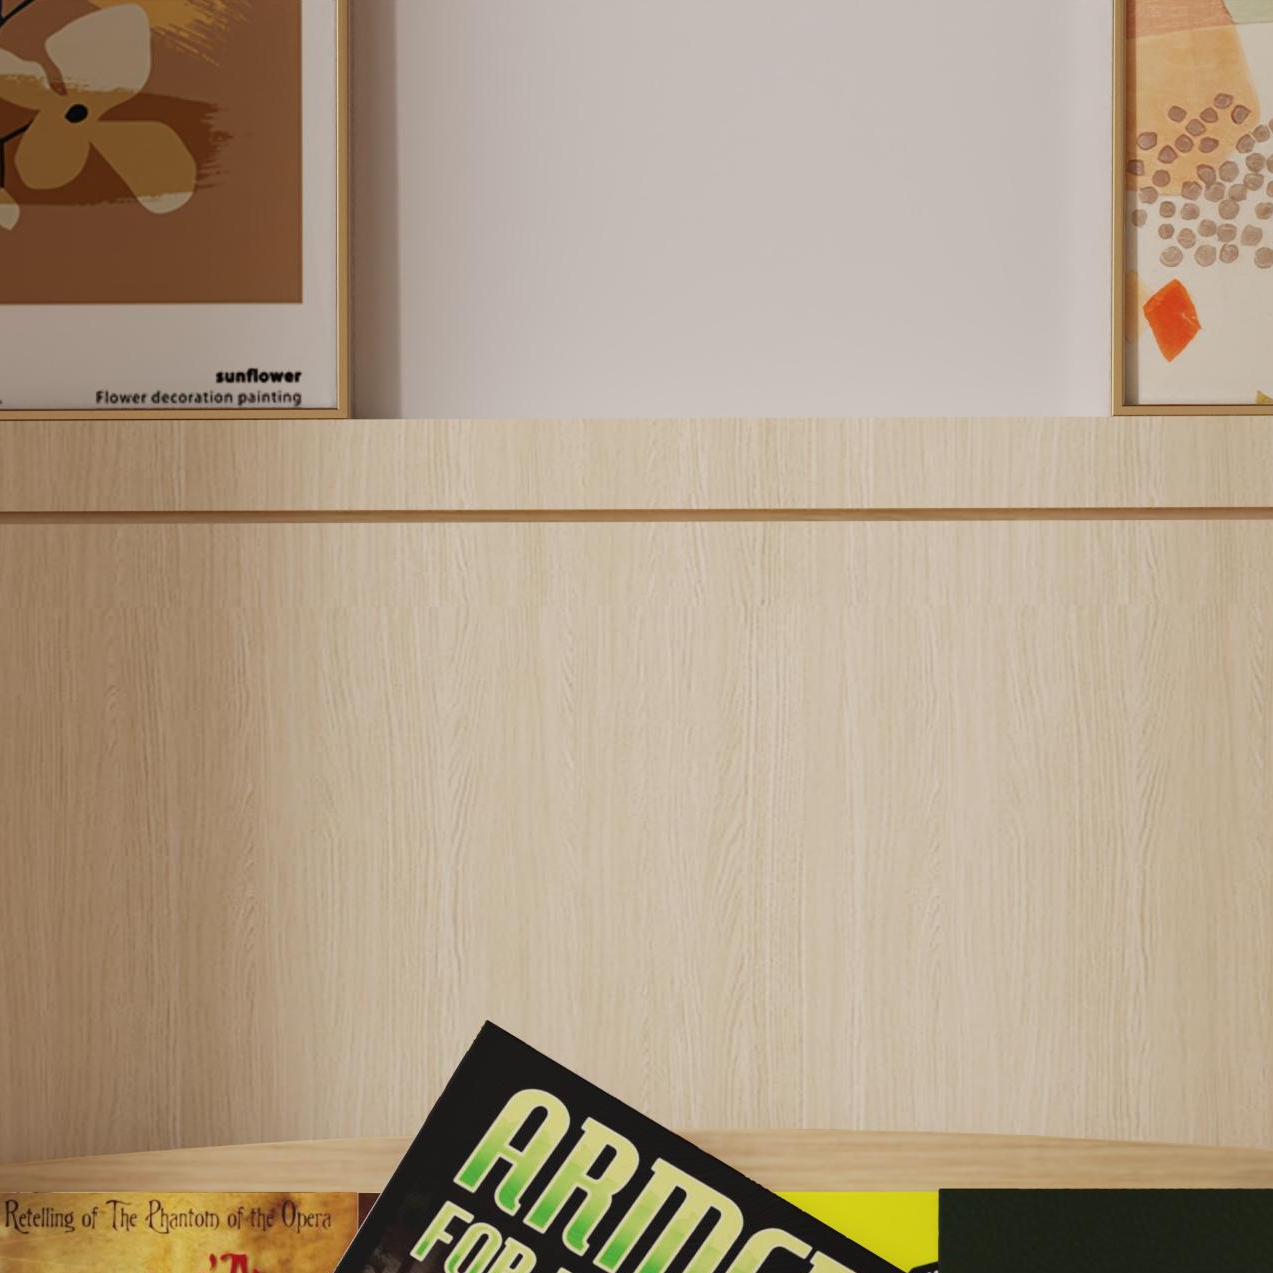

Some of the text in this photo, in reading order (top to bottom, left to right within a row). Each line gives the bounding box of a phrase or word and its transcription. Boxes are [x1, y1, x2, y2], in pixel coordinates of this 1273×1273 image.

[215, 368, 302, 383] sunflower
[95, 390, 302, 407] Flower decoration painting
[5, 1200, 74, 1234] Retelling
[81, 1205, 100, 1230] of
[106, 1200, 138, 1234] The
[146, 1199, 220, 1235] Phantom
[227, 1206, 245, 1230] of
[251, 1208, 275, 1232] the
[282, 1200, 332, 1234] Opera
